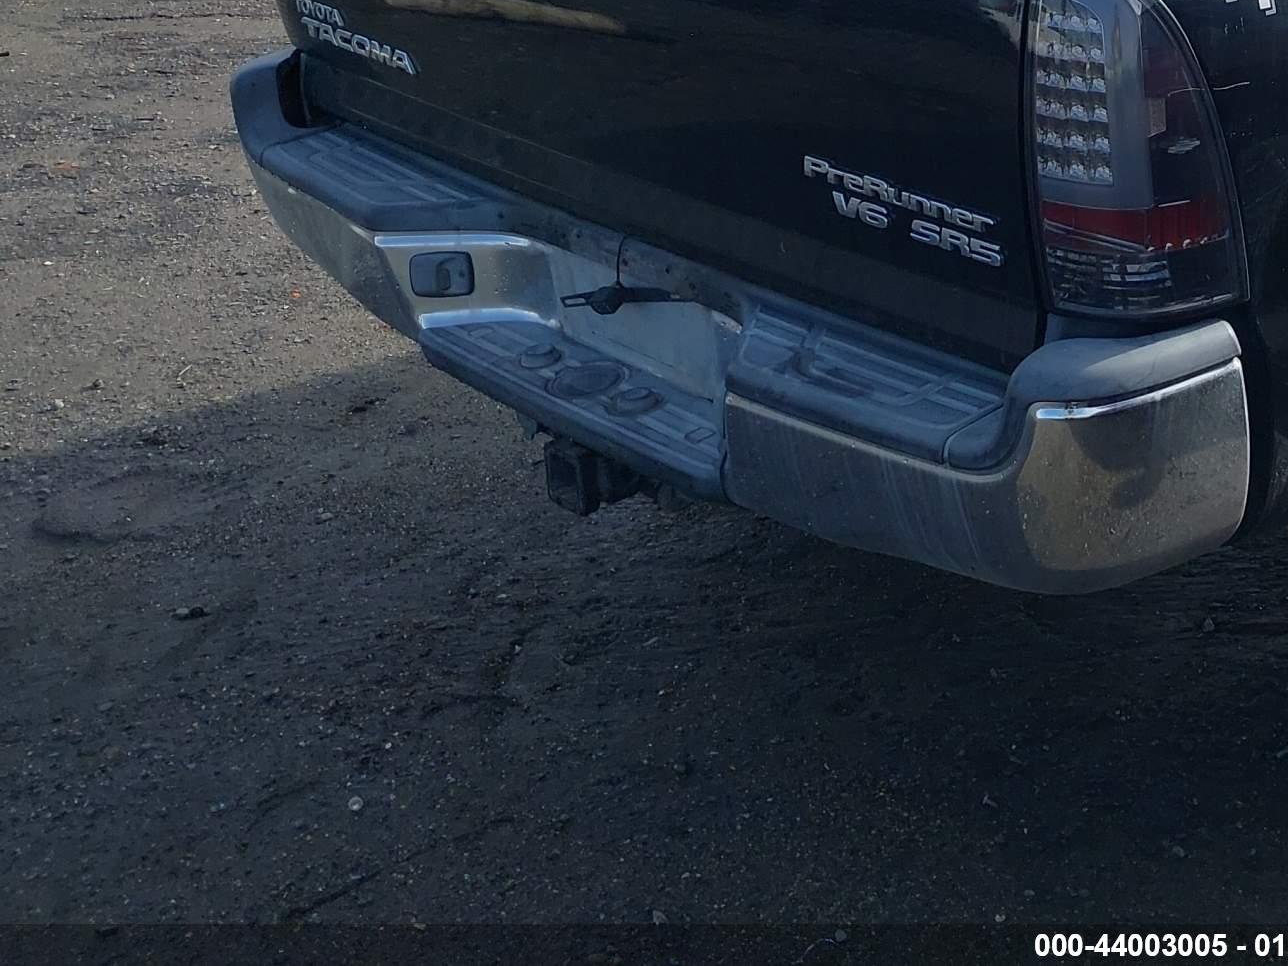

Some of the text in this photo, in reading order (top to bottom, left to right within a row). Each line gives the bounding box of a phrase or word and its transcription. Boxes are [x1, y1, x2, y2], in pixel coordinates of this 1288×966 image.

[300, 16, 417, 75] TACOMA
[803, 155, 996, 233] PreRunner
[831, 190, 1002, 267] V6 SR5
